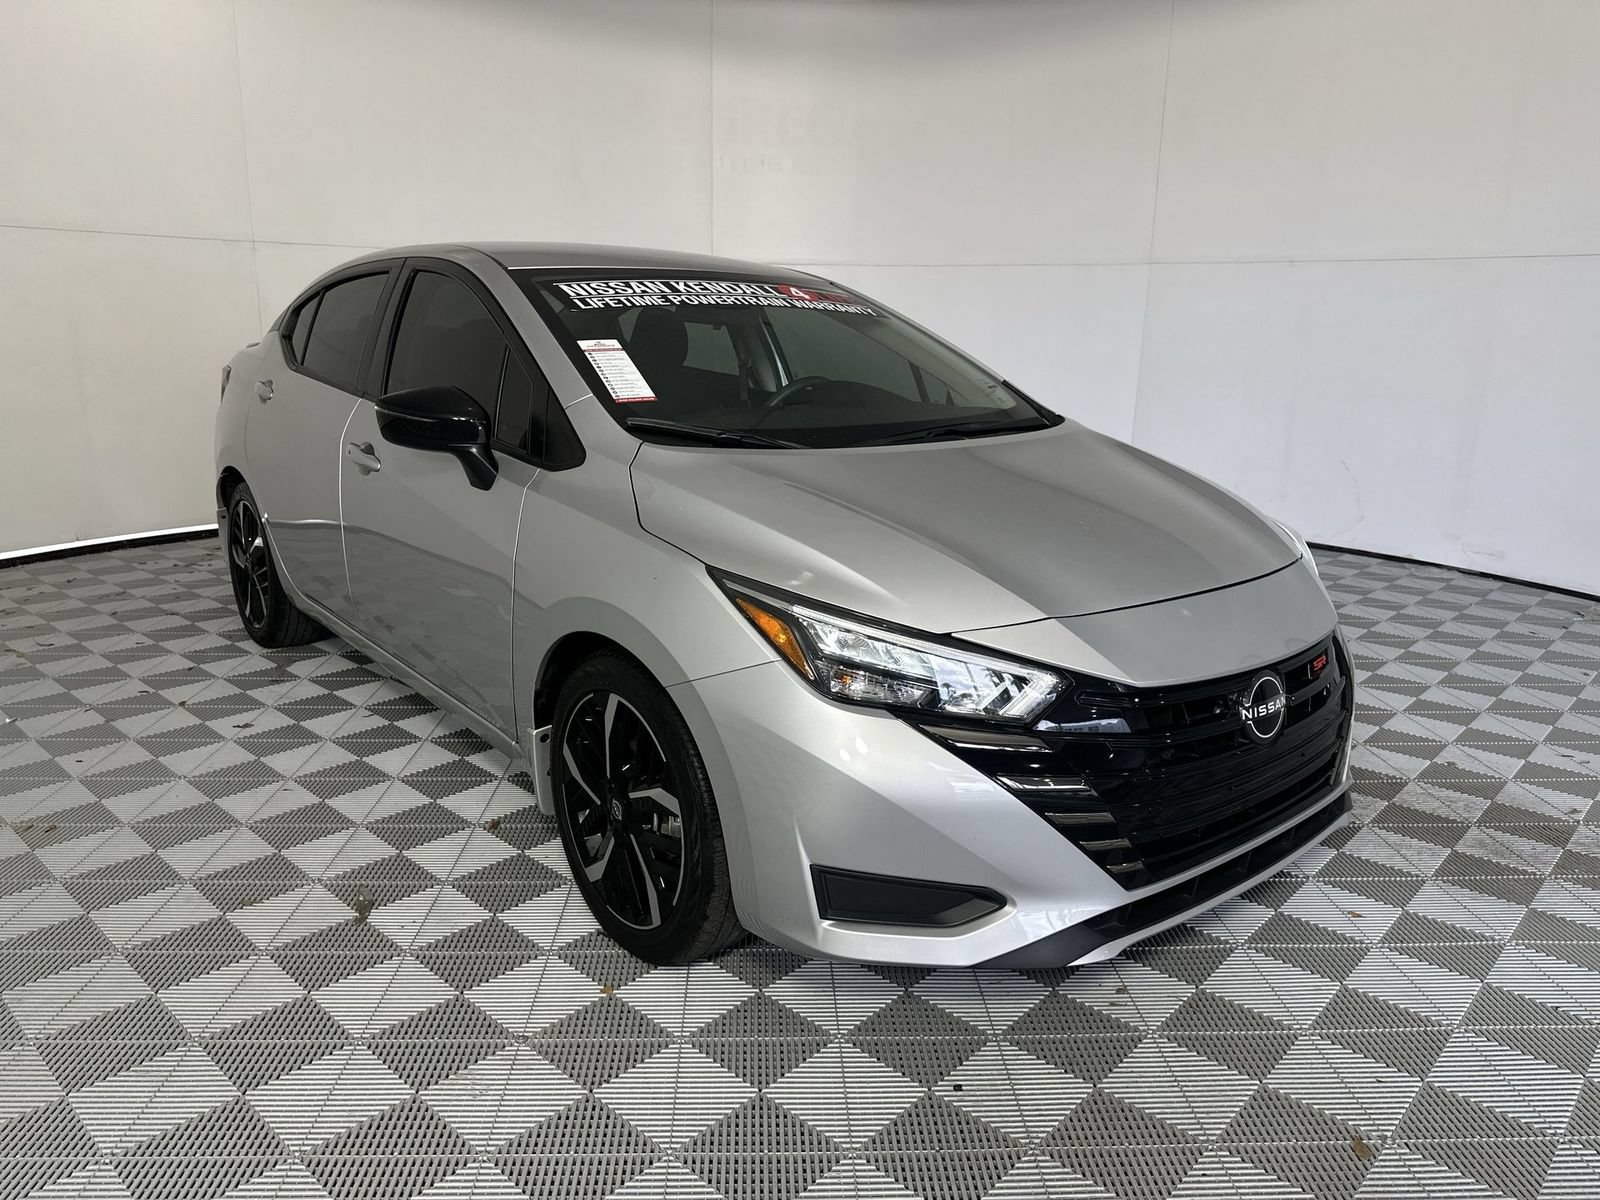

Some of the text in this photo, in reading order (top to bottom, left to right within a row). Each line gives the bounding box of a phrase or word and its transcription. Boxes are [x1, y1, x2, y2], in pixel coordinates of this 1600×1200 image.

[558, 281, 673, 297] NISSAN
[669, 281, 786, 298] KENDALL
[789, 287, 812, 300] 4
[572, 295, 877, 316] LIFETIME POWERTRAIN WARRANTY
[1312, 655, 1328, 671] SR
[1241, 697, 1286, 721] NISSAN
